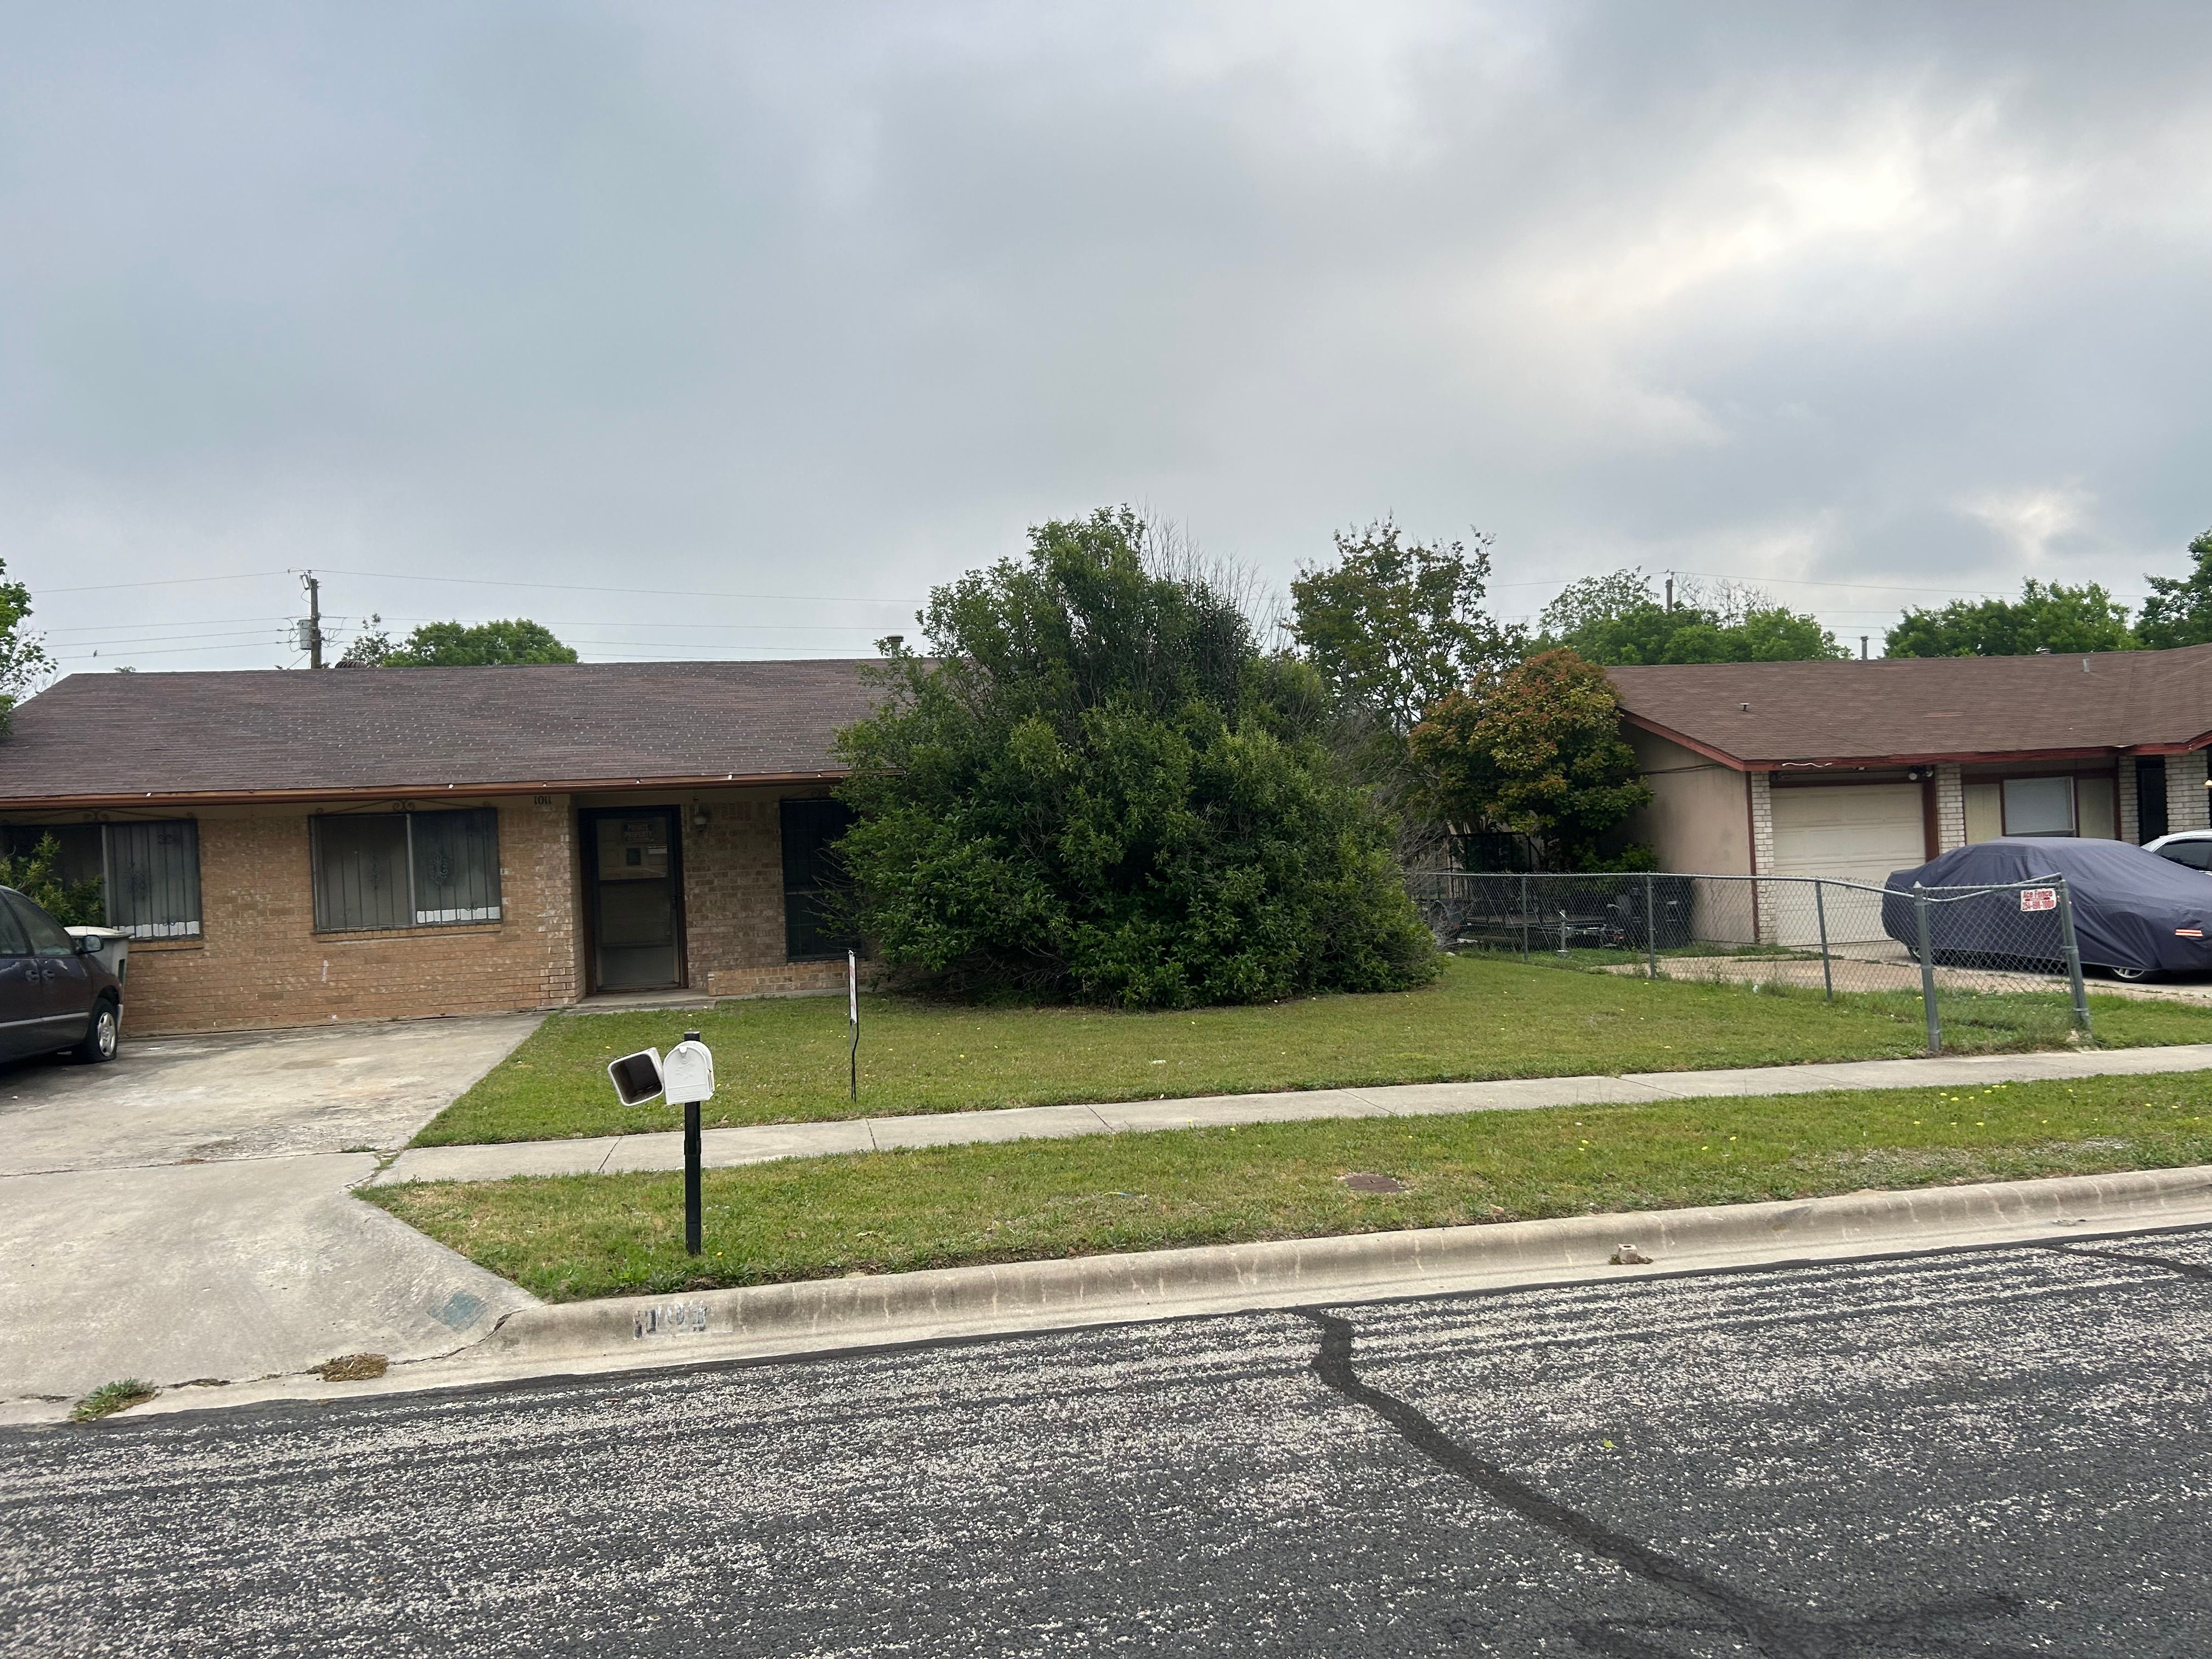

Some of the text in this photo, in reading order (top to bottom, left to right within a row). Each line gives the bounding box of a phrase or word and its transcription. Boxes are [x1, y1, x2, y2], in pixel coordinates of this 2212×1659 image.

[534, 795, 551, 805] 1011
[2023, 890, 2053, 899] Ace Fence
